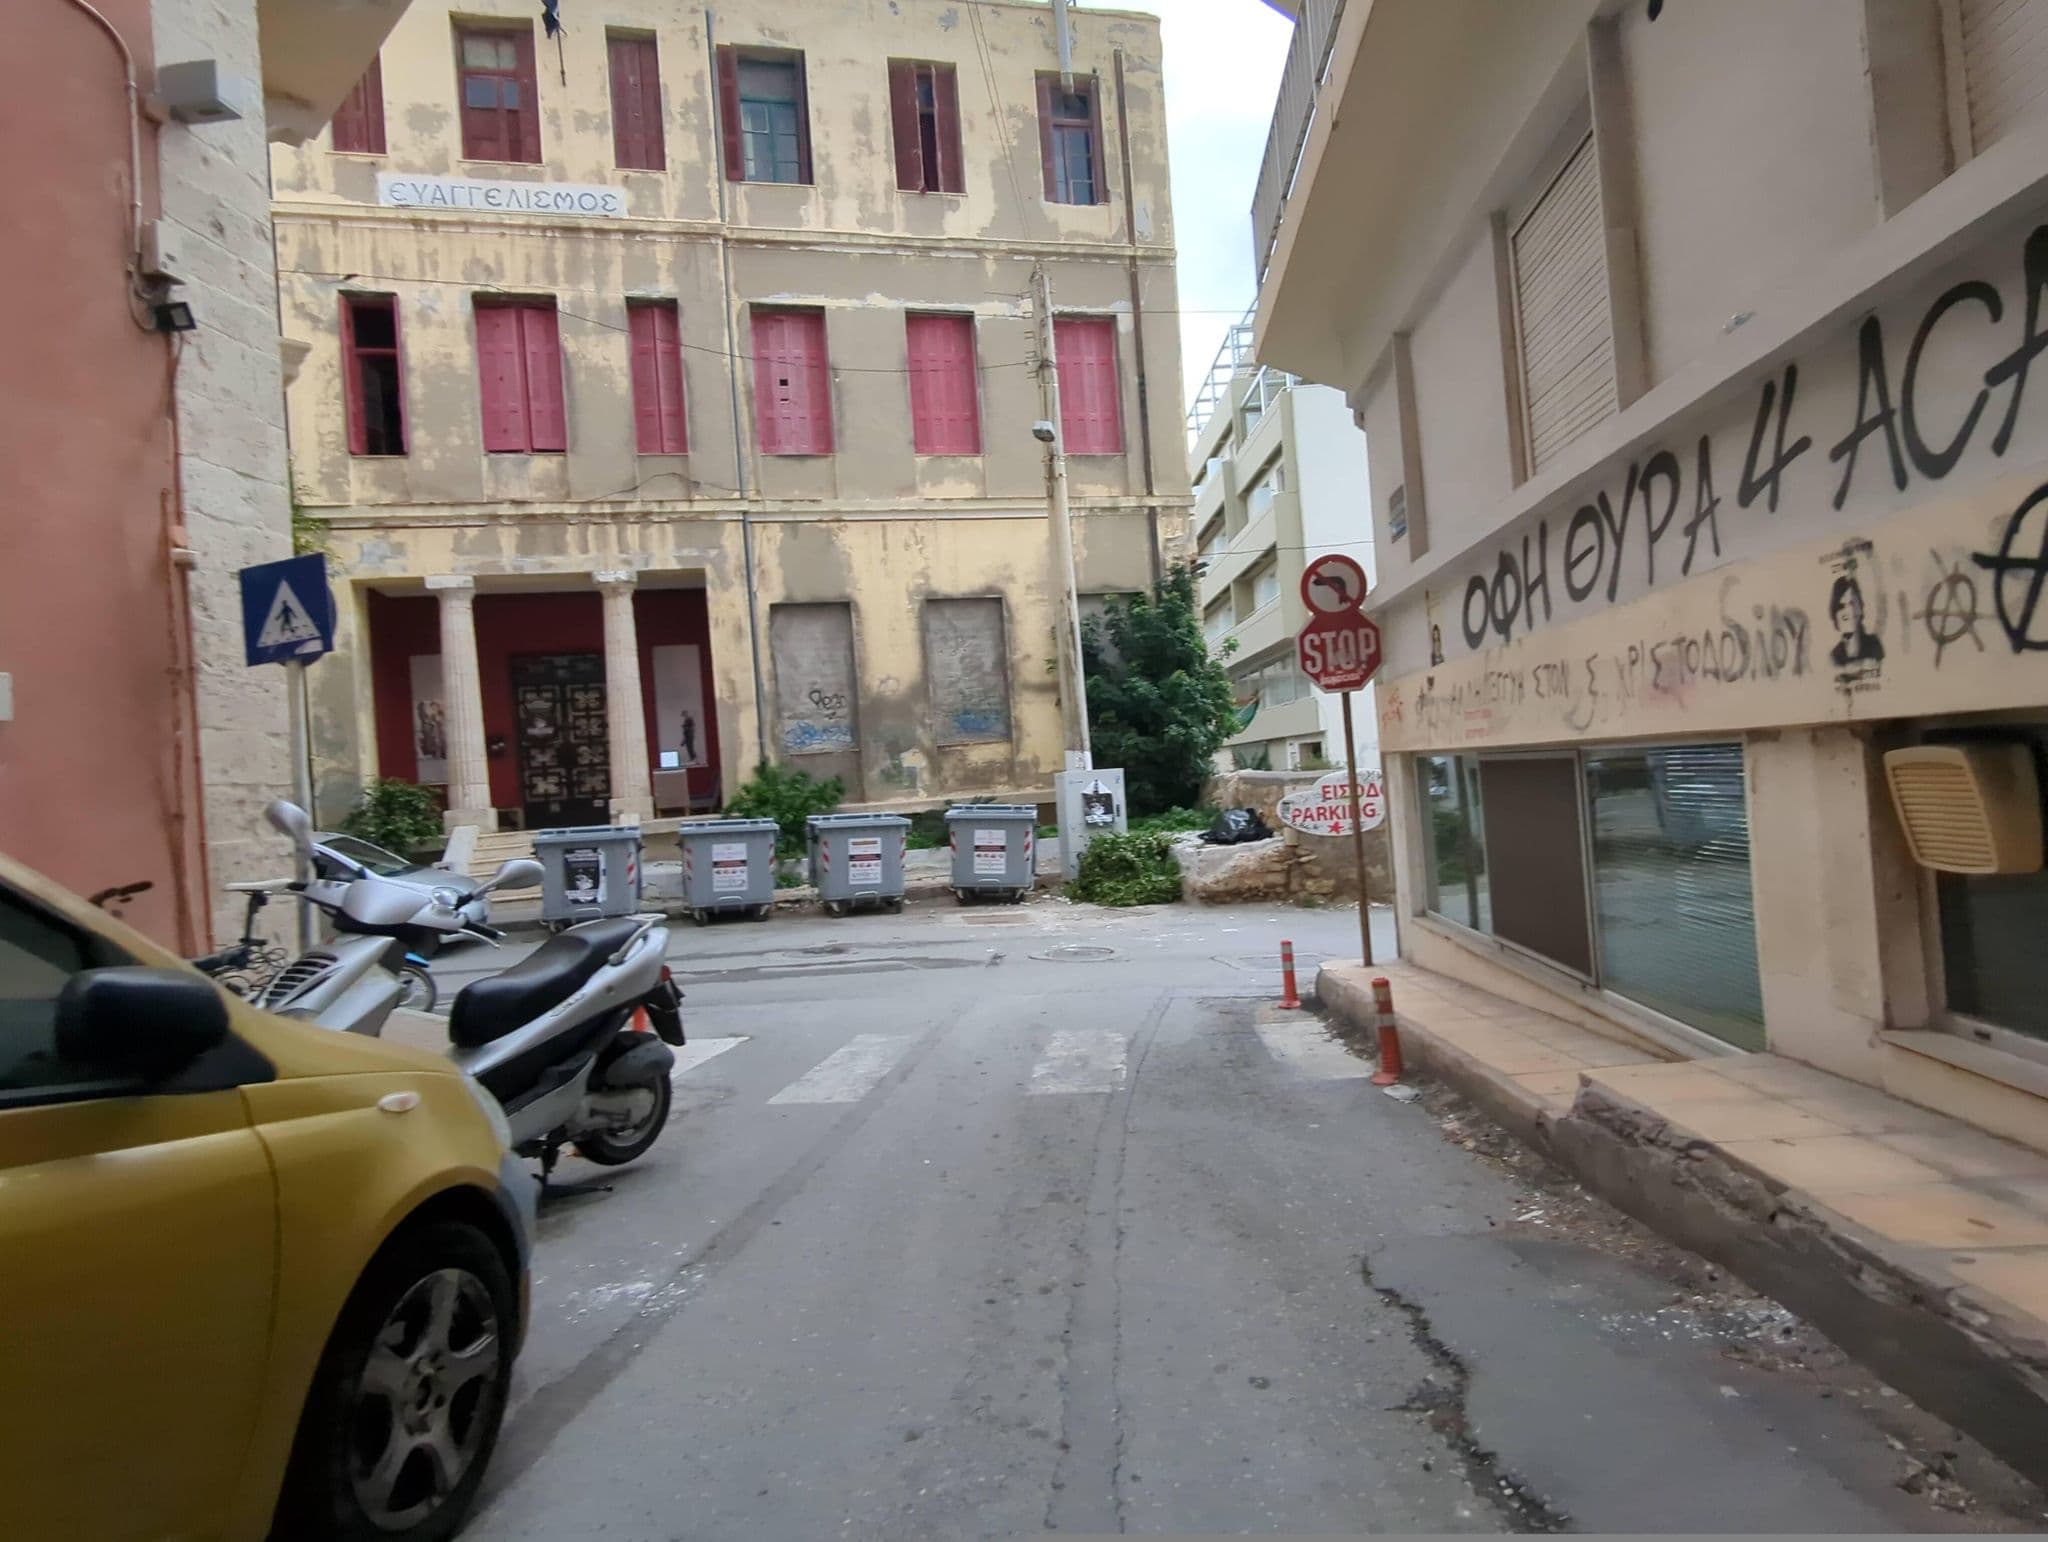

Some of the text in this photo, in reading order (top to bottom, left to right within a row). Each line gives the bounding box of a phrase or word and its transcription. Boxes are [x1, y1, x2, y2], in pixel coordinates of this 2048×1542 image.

[1463, 521, 1551, 648] ΟΦΗ
[1564, 436, 1720, 602] ΘΥΡΑ
[1738, 364, 1811, 513] 4
[1303, 628, 1377, 674] STOP
[1322, 783, 1383, 800] ΕΙΣΟΔ
[1291, 802, 1377, 823] PARKIG
